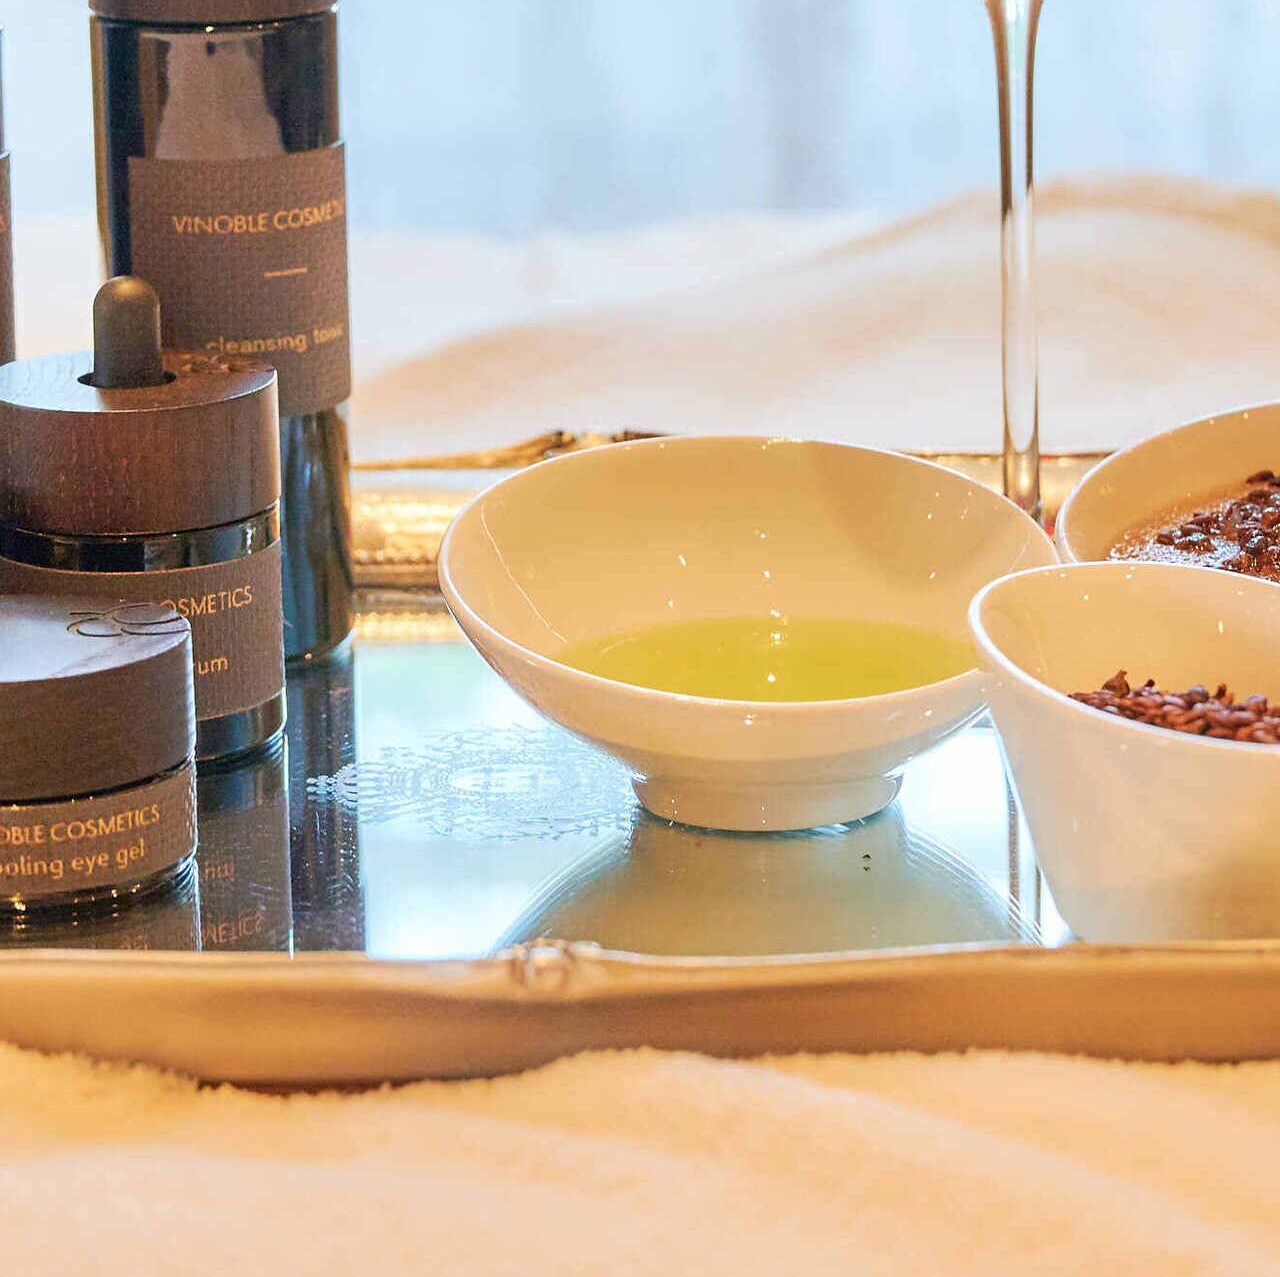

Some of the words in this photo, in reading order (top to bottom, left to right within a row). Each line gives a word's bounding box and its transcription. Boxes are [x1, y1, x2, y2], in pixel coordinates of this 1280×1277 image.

[172, 212, 269, 235] VINOBLE
[50, 803, 161, 843] COSMETICS
[71, 851, 109, 874] eye
[116, 837, 145, 869] gel
